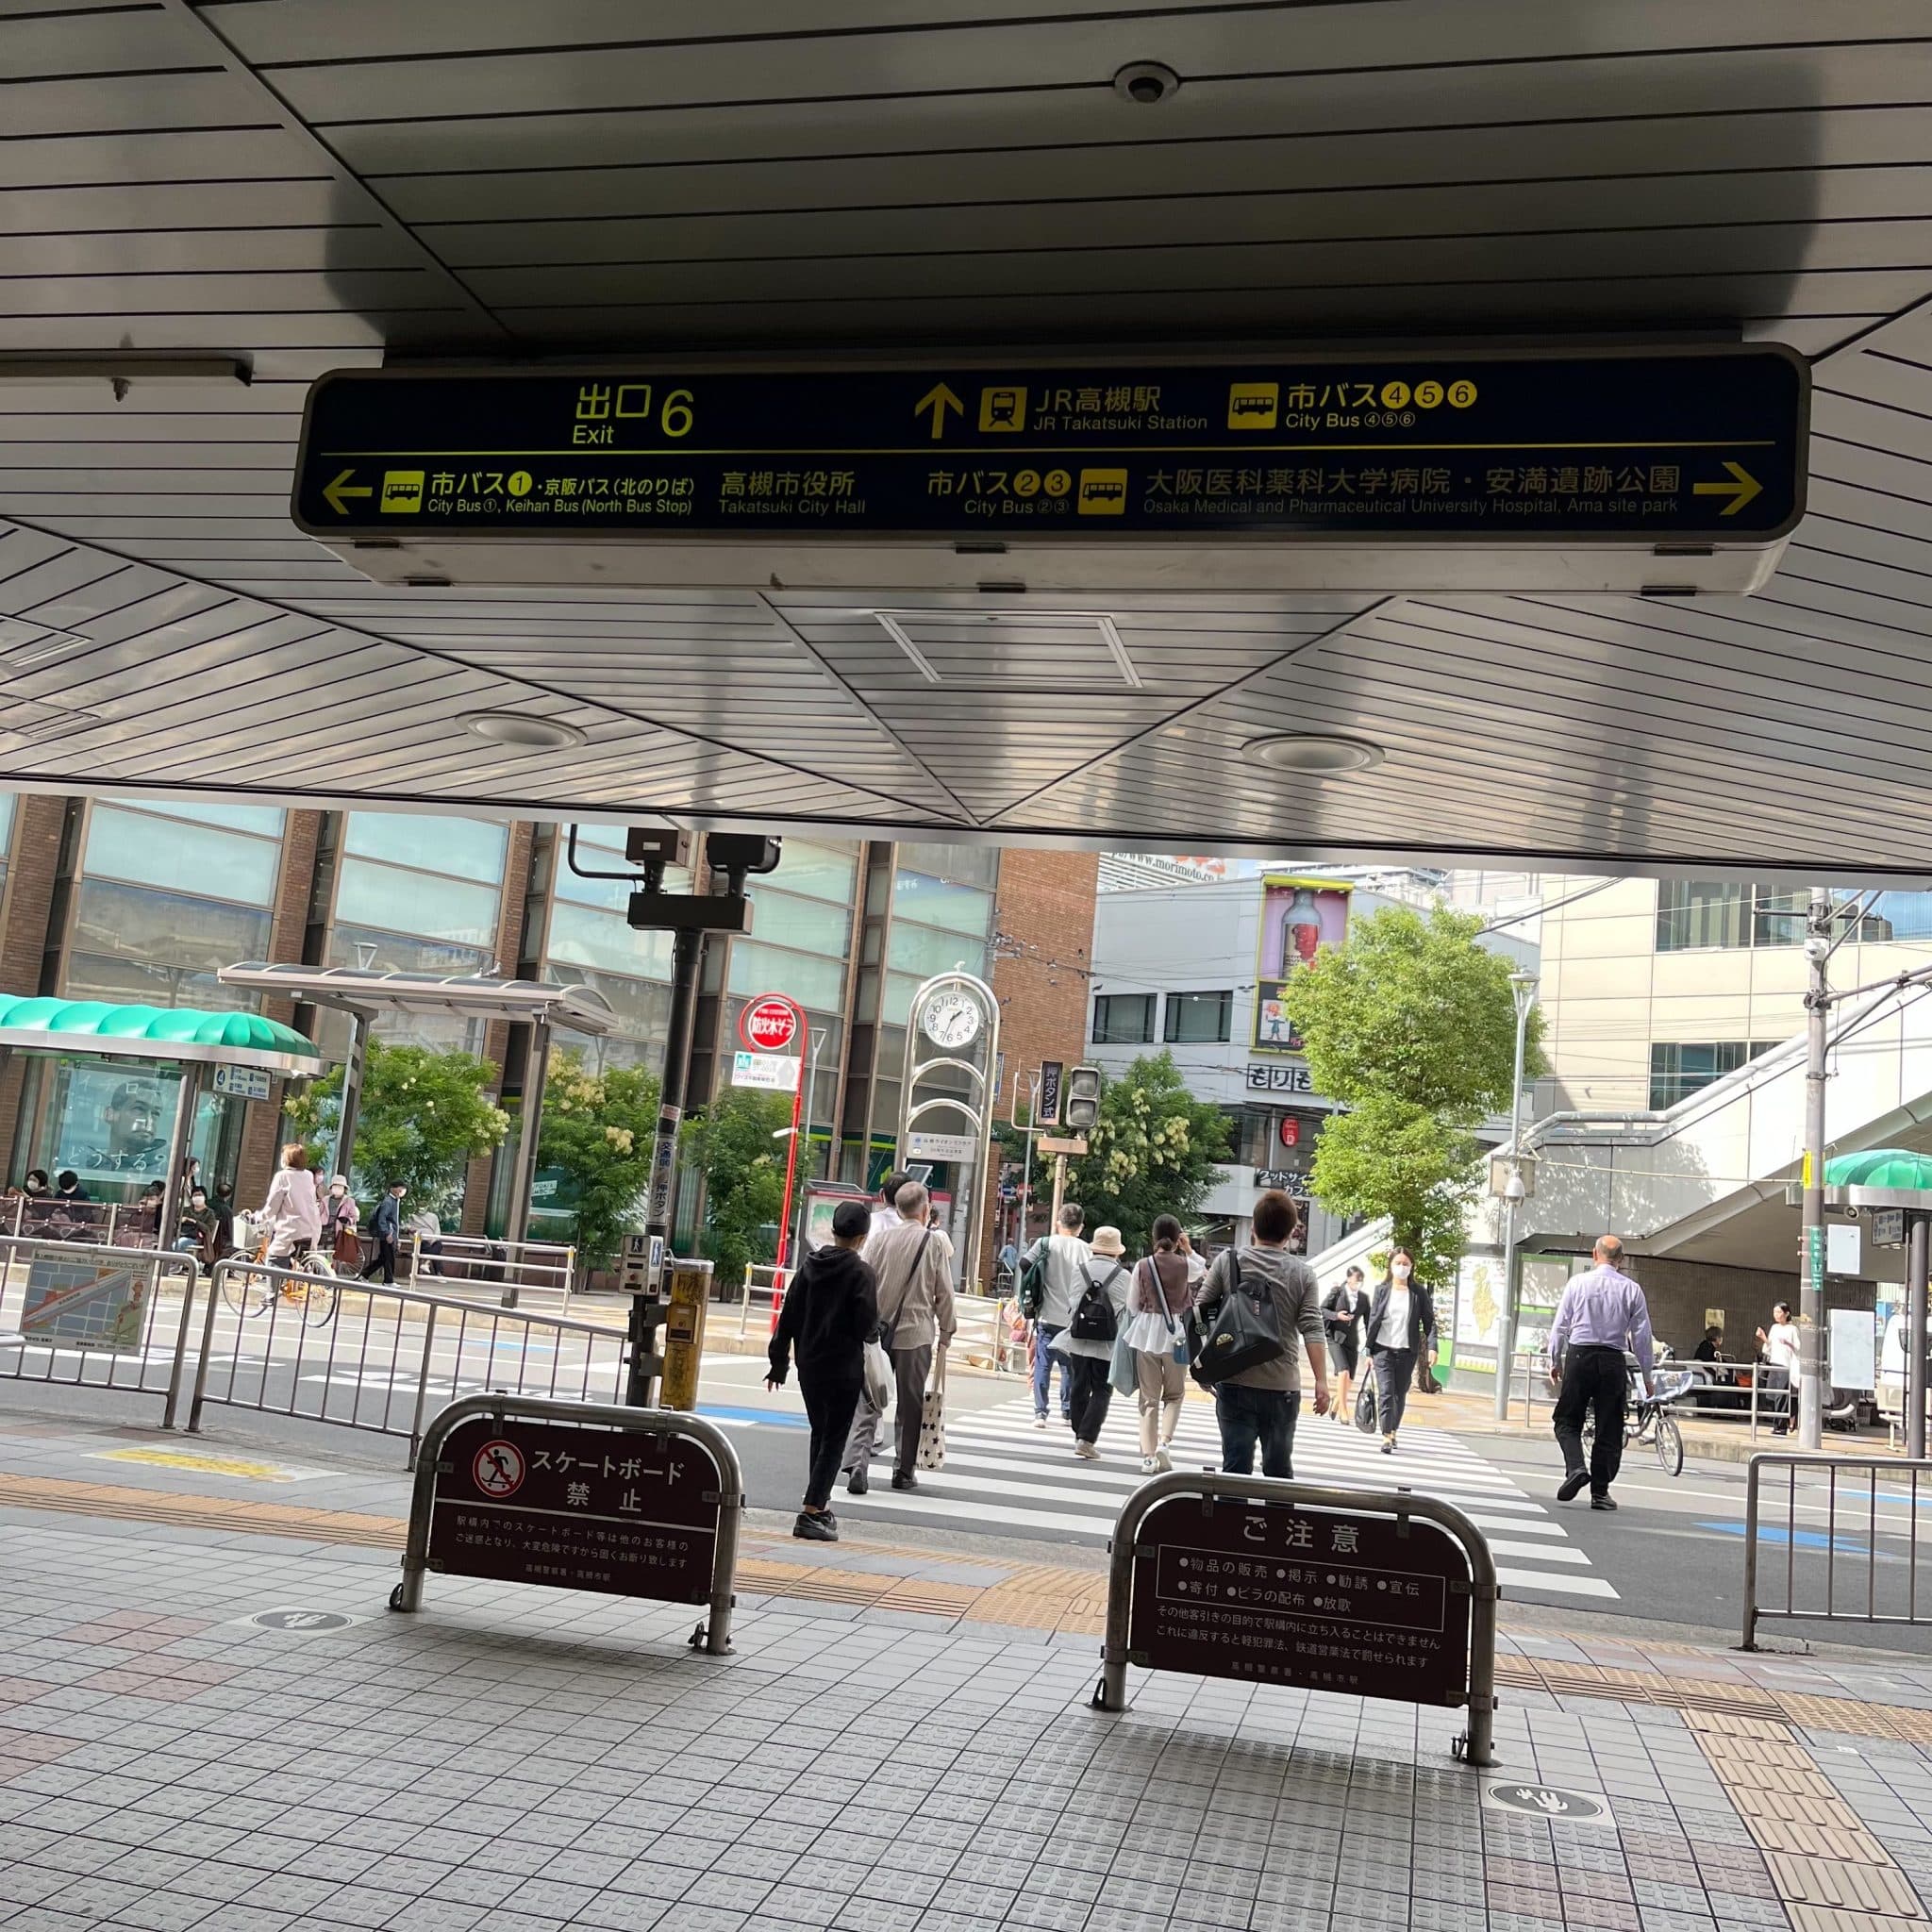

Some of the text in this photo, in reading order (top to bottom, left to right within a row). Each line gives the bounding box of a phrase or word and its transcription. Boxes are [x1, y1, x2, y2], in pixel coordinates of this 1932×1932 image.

[1035, 386, 1160, 412] JR高槻駅
[575, 383, 694, 437] 出口 6
[1034, 414, 1208, 431] JR Takatsuki Station
[1286, 413, 1320, 432] City
[1326, 412, 1360, 429] Bus
[573, 425, 614, 443] Exit
[721, 470, 855, 497] 高槻市役所
[427, 499, 453, 515] City
[458, 499, 481, 512] Bus
[506, 500, 550, 512] Keihan
[555, 500, 578, 512] Bus
[582, 499, 622, 514] (North
[626, 500, 652, 513] Bus
[656, 499, 691, 516] Stop)
[719, 499, 865, 518] Takatsuki City Hall
[964, 500, 996, 518] City
[1002, 500, 1033, 514] Bus
[1143, 497, 1677, 515] Osaka Medical and Pharmaceutical University Hospital, Ama site park
[1042, 1067, 1058, 1118] 押ボタン式
[531, 1449, 686, 1486] スケートボード
[1243, 1515, 1360, 1555] ご注意
